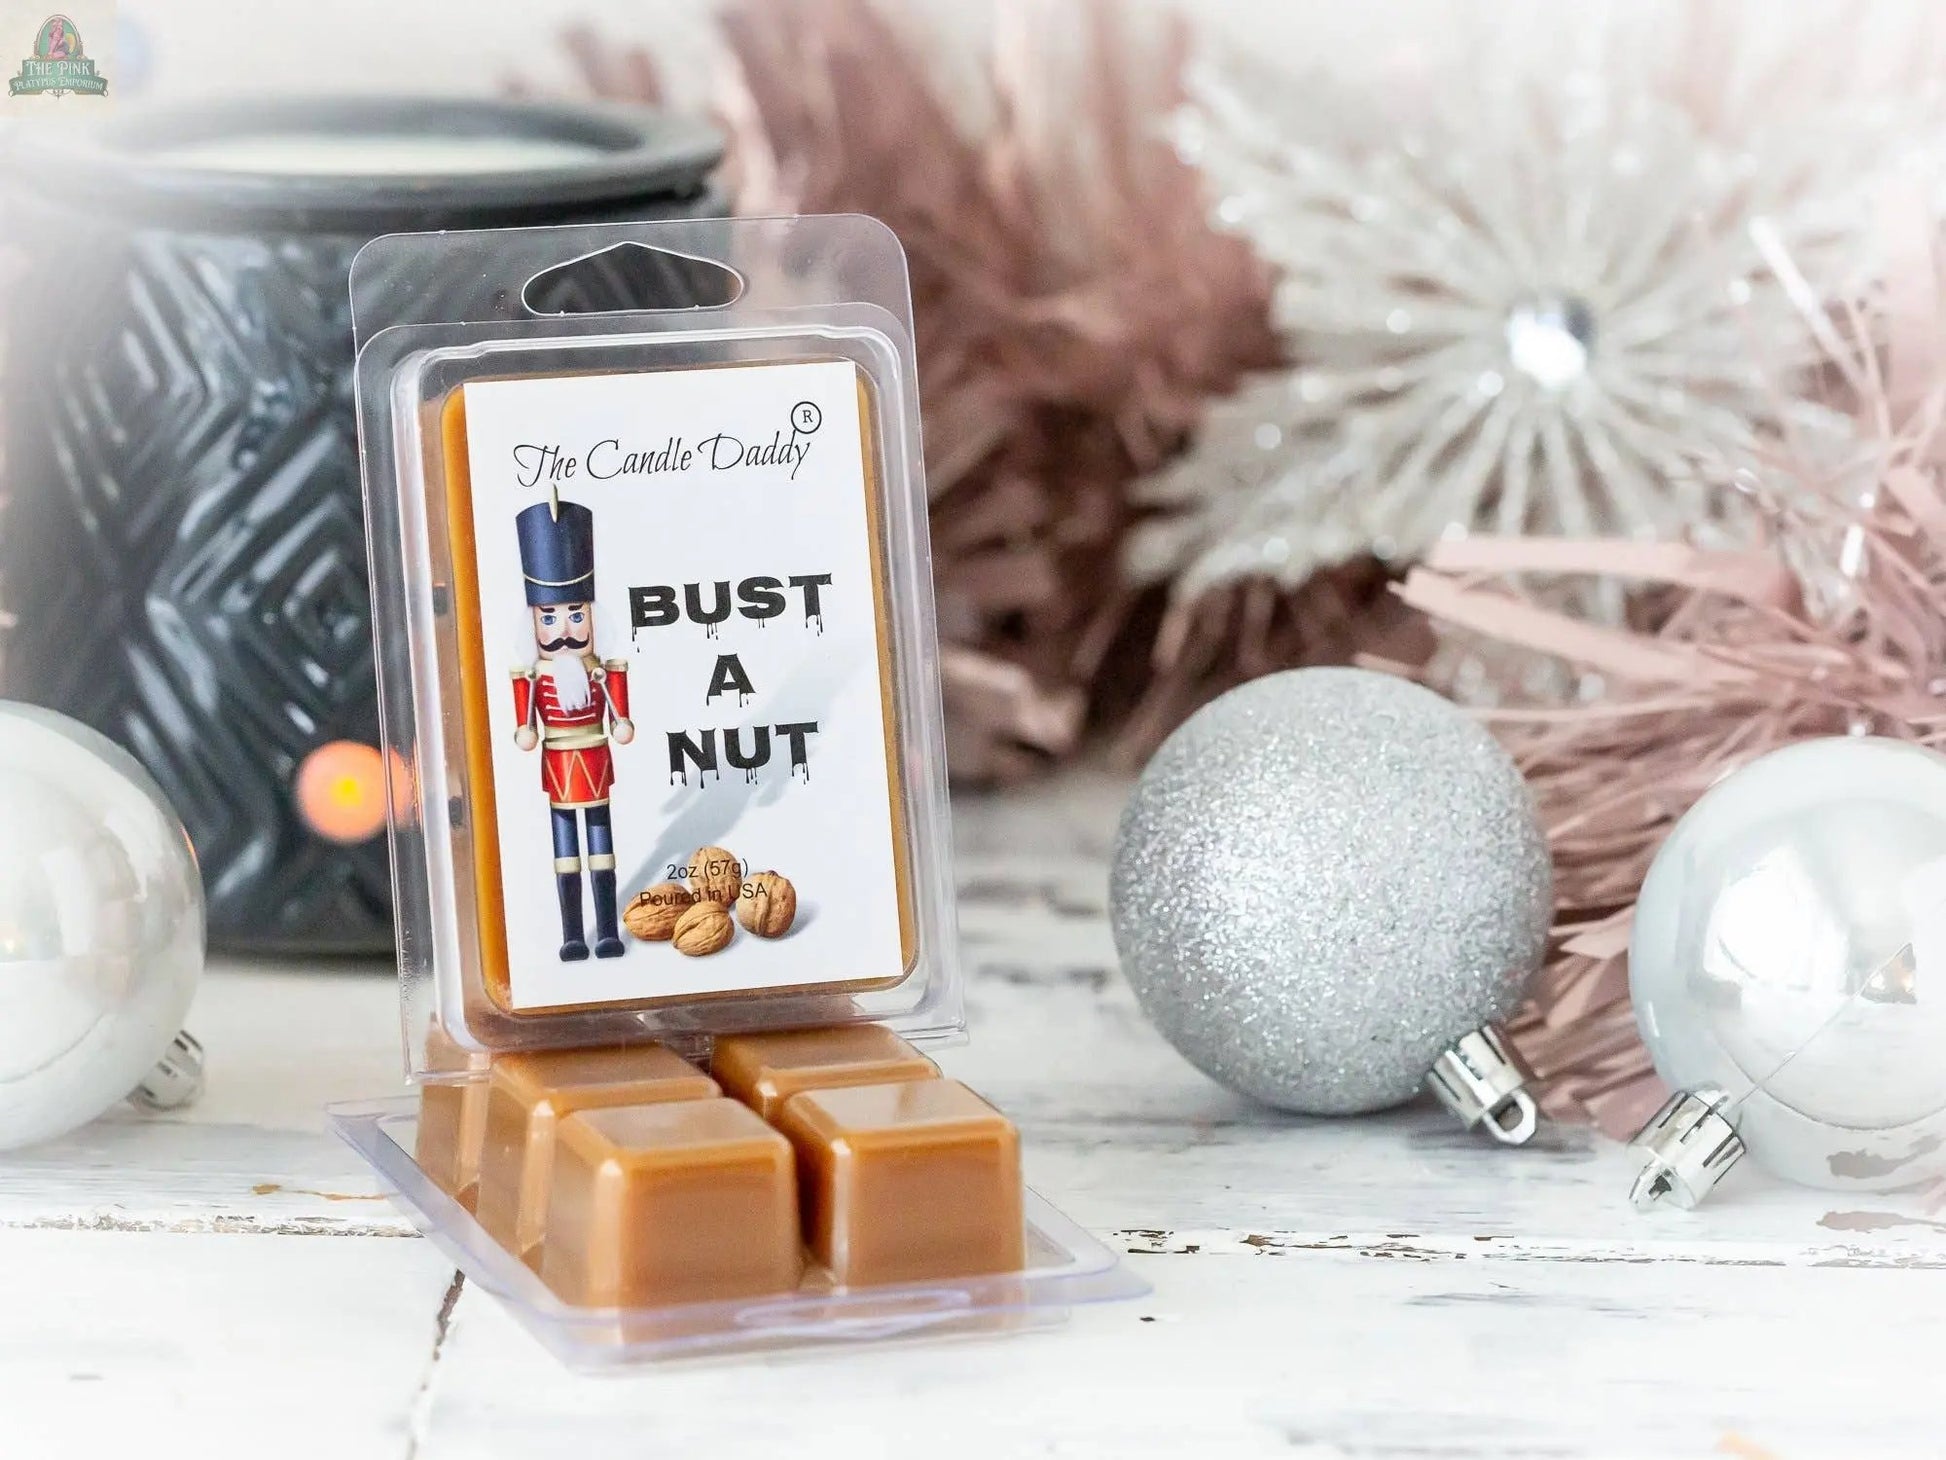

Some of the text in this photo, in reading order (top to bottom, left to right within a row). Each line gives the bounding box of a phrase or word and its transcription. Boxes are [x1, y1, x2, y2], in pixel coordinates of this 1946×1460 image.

[513, 444, 577, 487] The
[586, 437, 693, 480] Candle
[697, 429, 811, 480] Daddy
[628, 572, 833, 641] BUST
[706, 653, 756, 708] A
[666, 721, 819, 789] NUT
[640, 882, 768, 907] Poured in USA
[666, 858, 749, 880] 2oz (57g)
